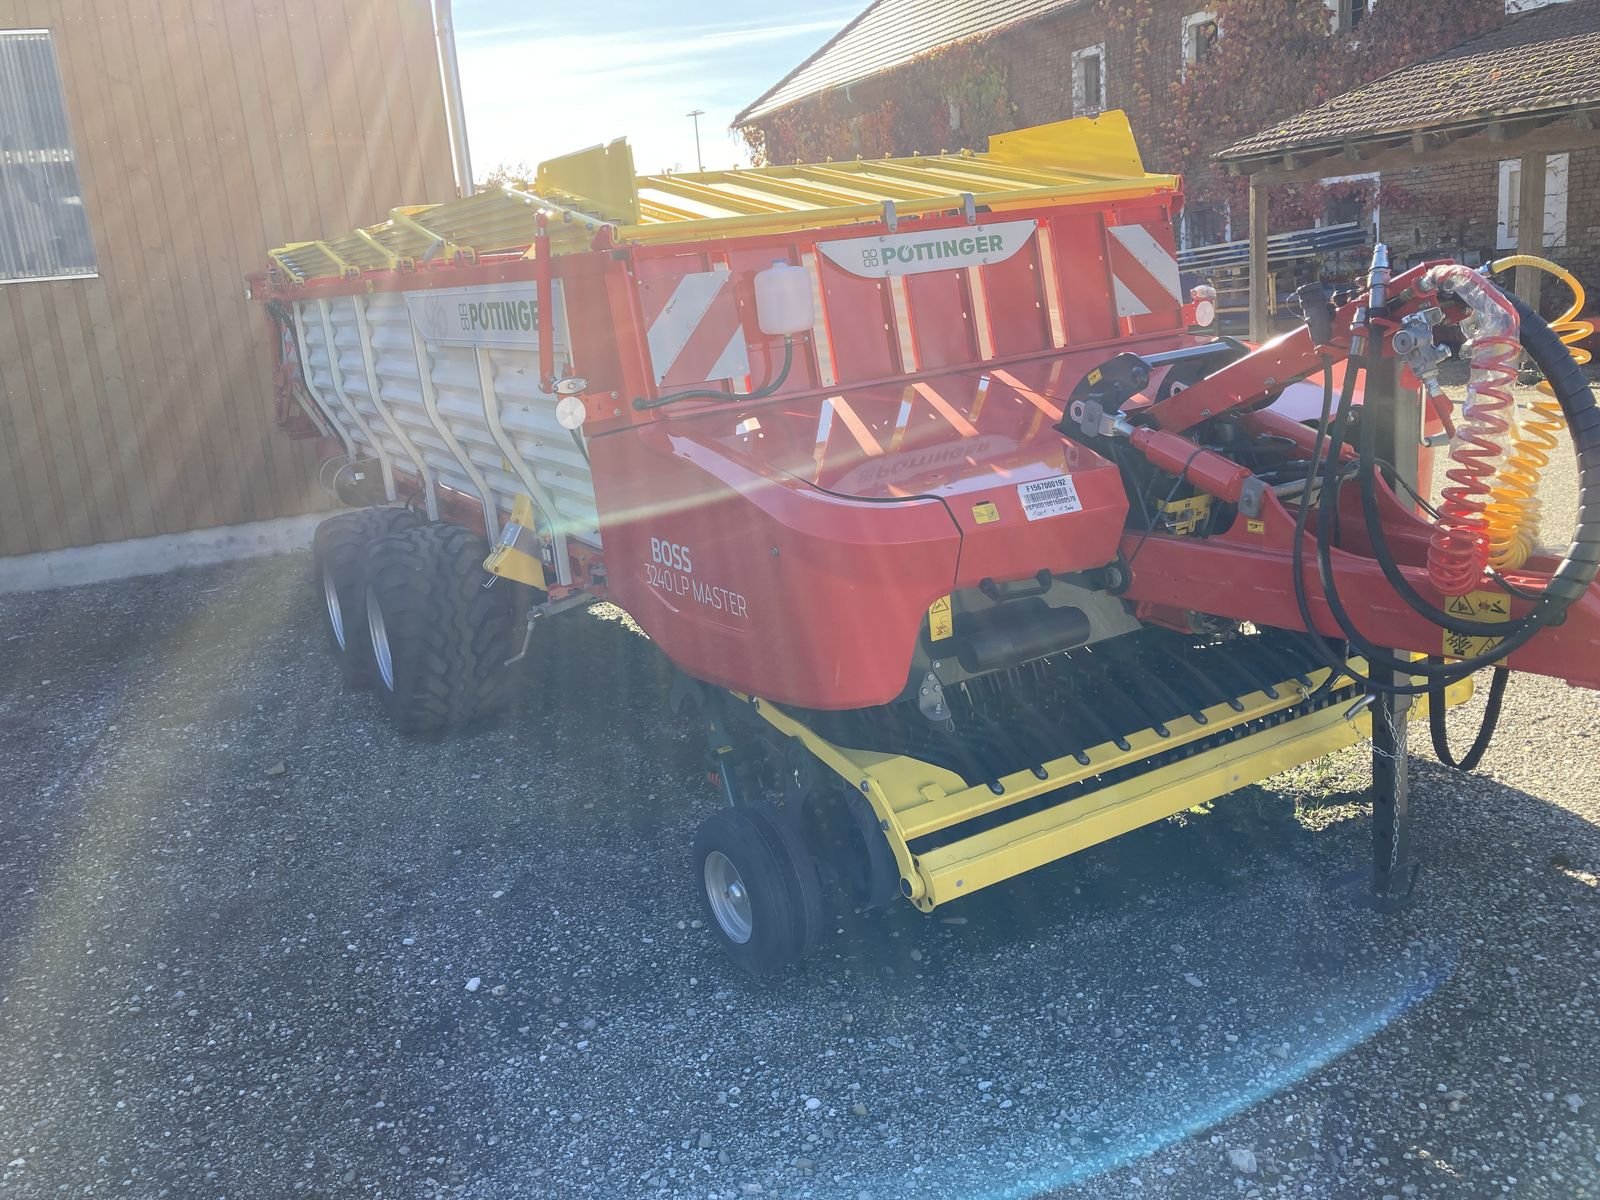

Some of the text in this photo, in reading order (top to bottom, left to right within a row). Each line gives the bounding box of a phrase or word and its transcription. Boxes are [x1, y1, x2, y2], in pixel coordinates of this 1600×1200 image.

[468, 299, 542, 332] PÖTTINGE
[651, 537, 692, 573] BOSS
[644, 563, 748, 620] 3240 LP MASTER
